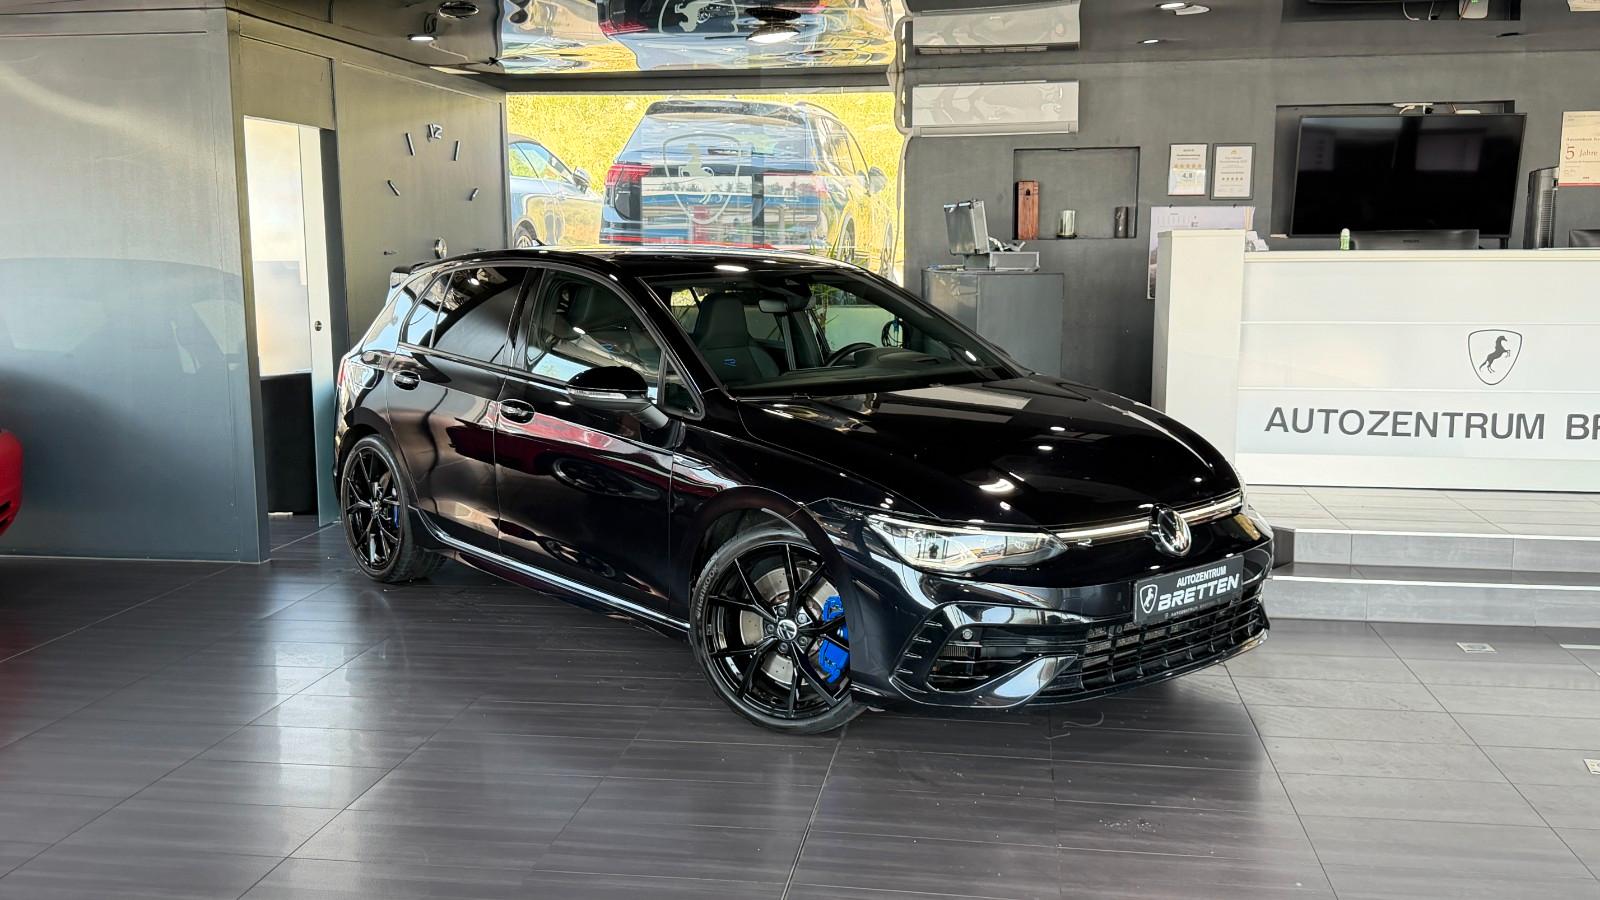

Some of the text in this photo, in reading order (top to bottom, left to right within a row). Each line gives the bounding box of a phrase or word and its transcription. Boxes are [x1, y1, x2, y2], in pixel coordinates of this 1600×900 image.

[428, 123, 443, 139] 12
[1565, 145, 1575, 160] 5
[1264, 406, 1545, 440] AUTOZENTRUM
[1176, 565, 1227, 588] AUTOZENTRUM
[1157, 573, 1240, 612] BRETTEN
